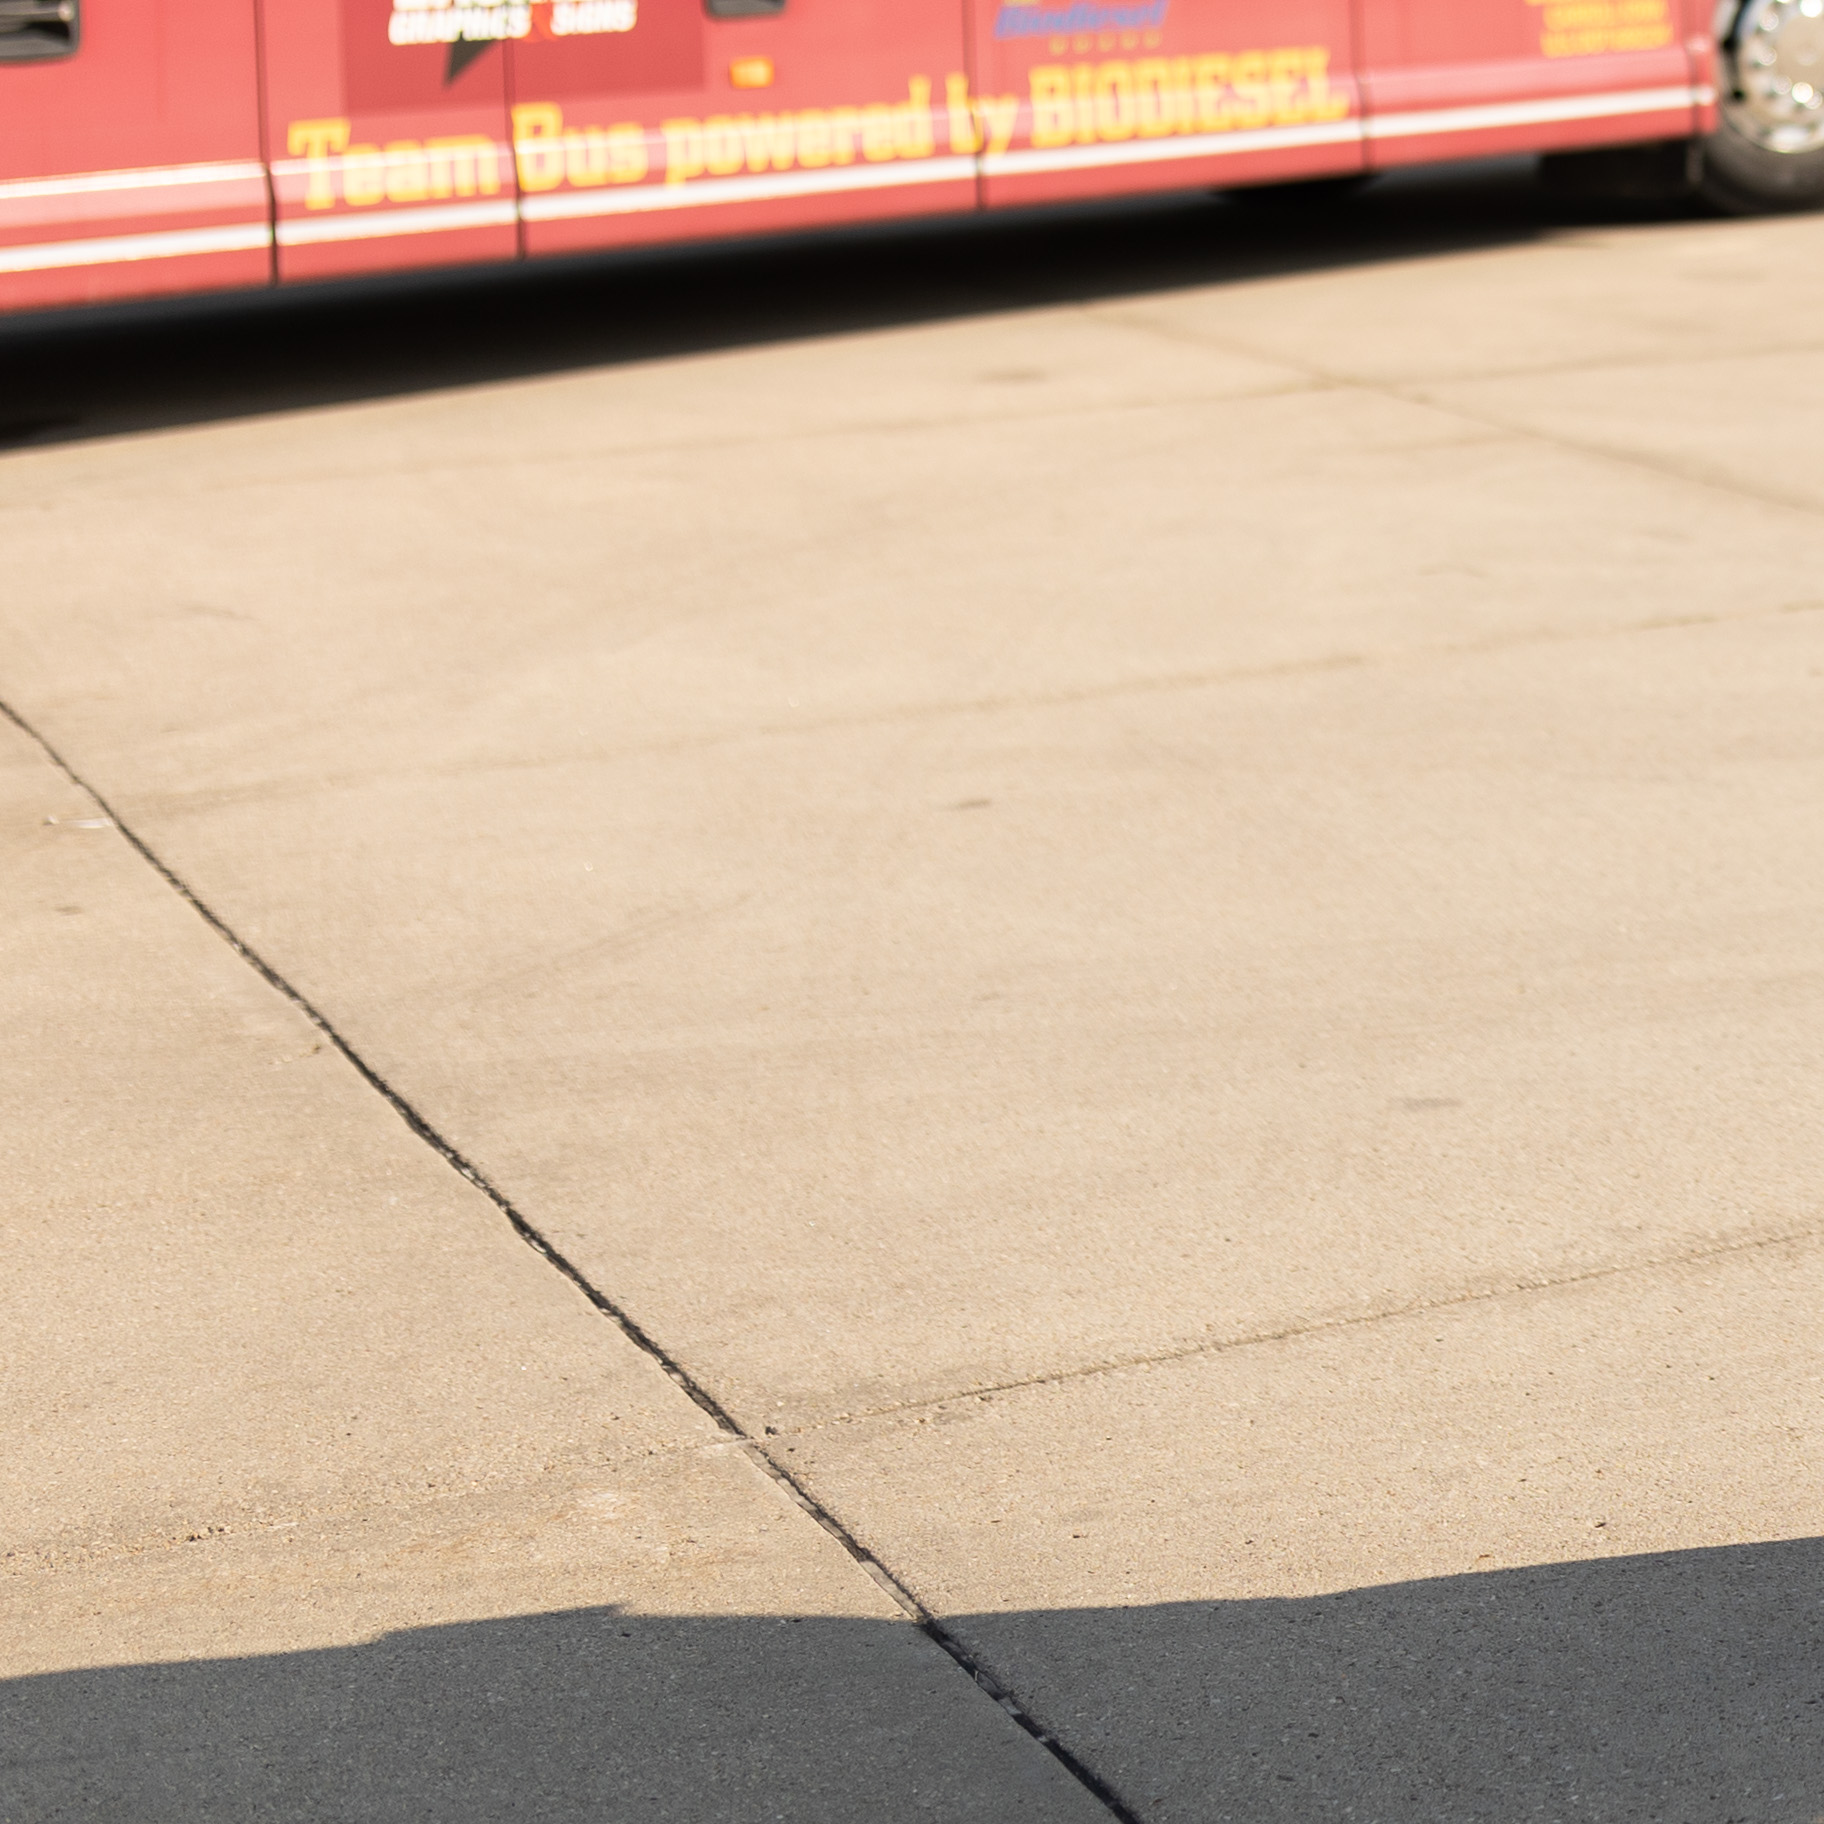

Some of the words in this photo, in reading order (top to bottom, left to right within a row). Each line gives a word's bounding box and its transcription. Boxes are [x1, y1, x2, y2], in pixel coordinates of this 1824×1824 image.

[549, 0, 639, 37] SIGNS
[287, 116, 501, 210] Team
[511, 100, 649, 193] Bus
[661, 74, 933, 190] powered
[945, 71, 1019, 157] by
[1028, 46, 1351, 149] BIODIESEL
